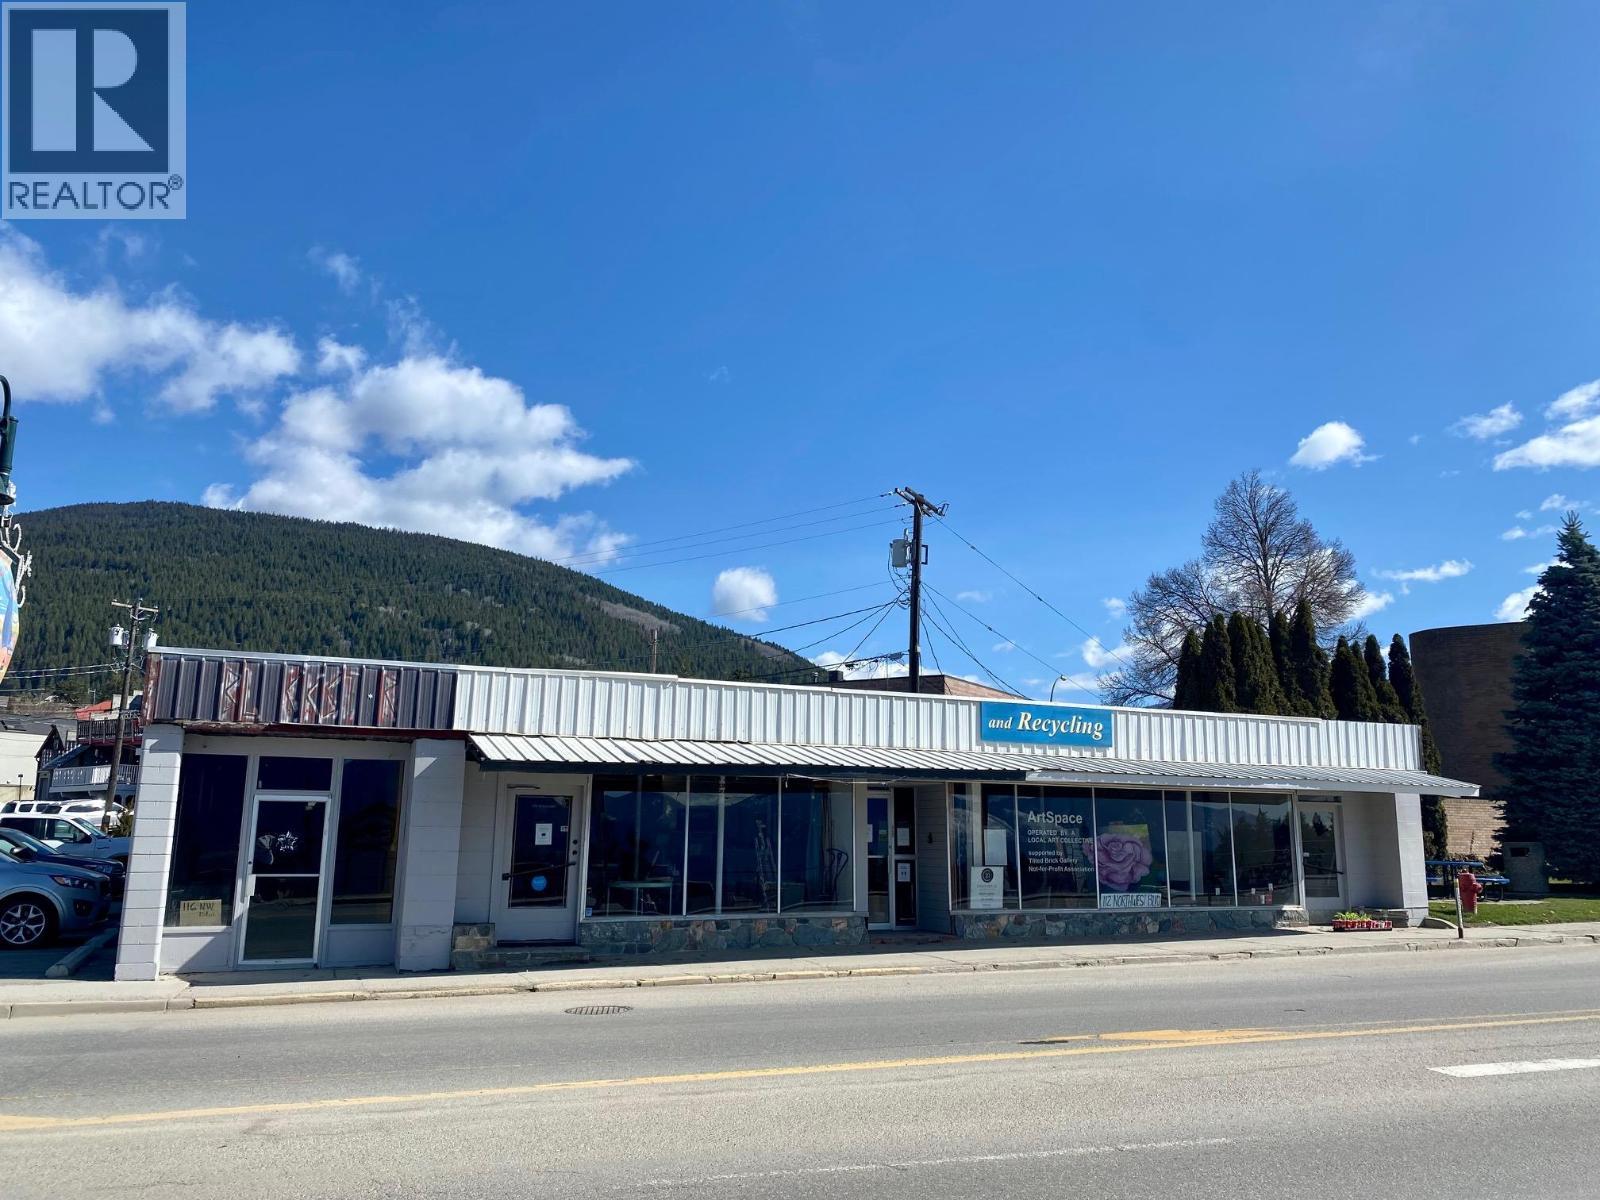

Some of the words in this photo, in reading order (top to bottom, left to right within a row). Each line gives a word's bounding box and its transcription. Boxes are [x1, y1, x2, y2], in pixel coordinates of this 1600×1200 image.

[988, 717, 1013, 729] and
[1018, 711, 1104, 741] Recycling
[1027, 810, 1083, 826] ArtSpace
